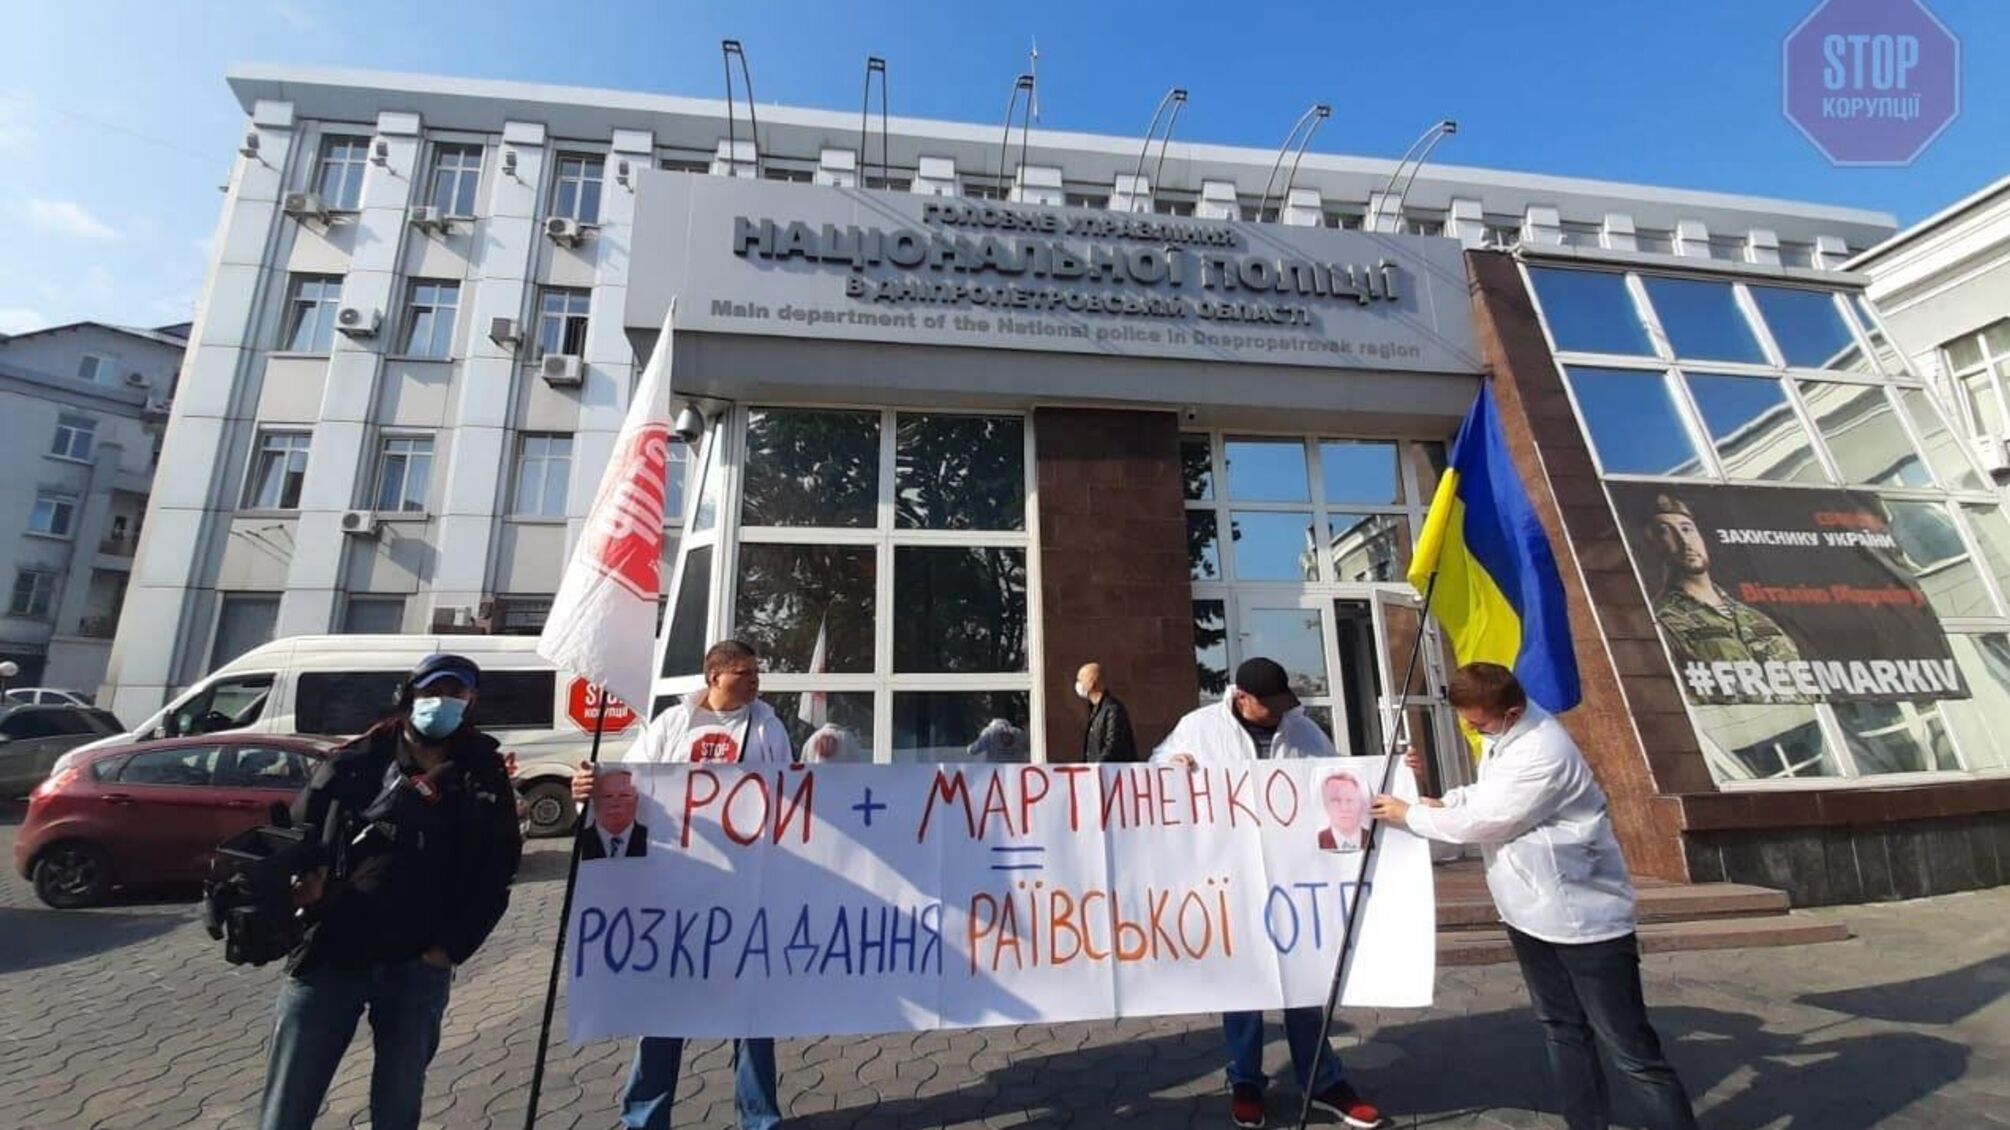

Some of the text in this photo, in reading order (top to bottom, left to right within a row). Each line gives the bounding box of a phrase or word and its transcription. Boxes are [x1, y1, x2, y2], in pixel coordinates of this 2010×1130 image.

[923, 203, 1237, 247] ГОЛОВНЕ УПРАВЛІННЯ
[733, 216, 1400, 306] НАЦІОНАЛЬНОЇ ПОЛІЦІЇ
[845, 275, 1312, 327] В ДНІПРОПЕТРОВСЬКІЙ ОБЛАСТІ
[710, 300, 770, 320] Main
[777, 304, 918, 328] department
[924, 314, 947, 329] of
[954, 315, 990, 333] the
[997, 318, 1090, 339] National
[1096, 326, 1162, 343] police
[1168, 329, 1188, 344] in
[1360, 342, 1421, 360] region
[1716, 529, 1896, 549] ЗАХИСНИКУ УКРАЇНИ
[1685, 658, 1962, 696] #FREEMARKIV
[701, 742, 729, 757] STOP
[680, 764, 814, 847] РОЙ
[917, 766, 1297, 843] МАРТИНЕНКО
[575, 903, 942, 979] РОЗКРАДАННЯ
[969, 878, 1232, 976] РАЇВСЬКОЇ
